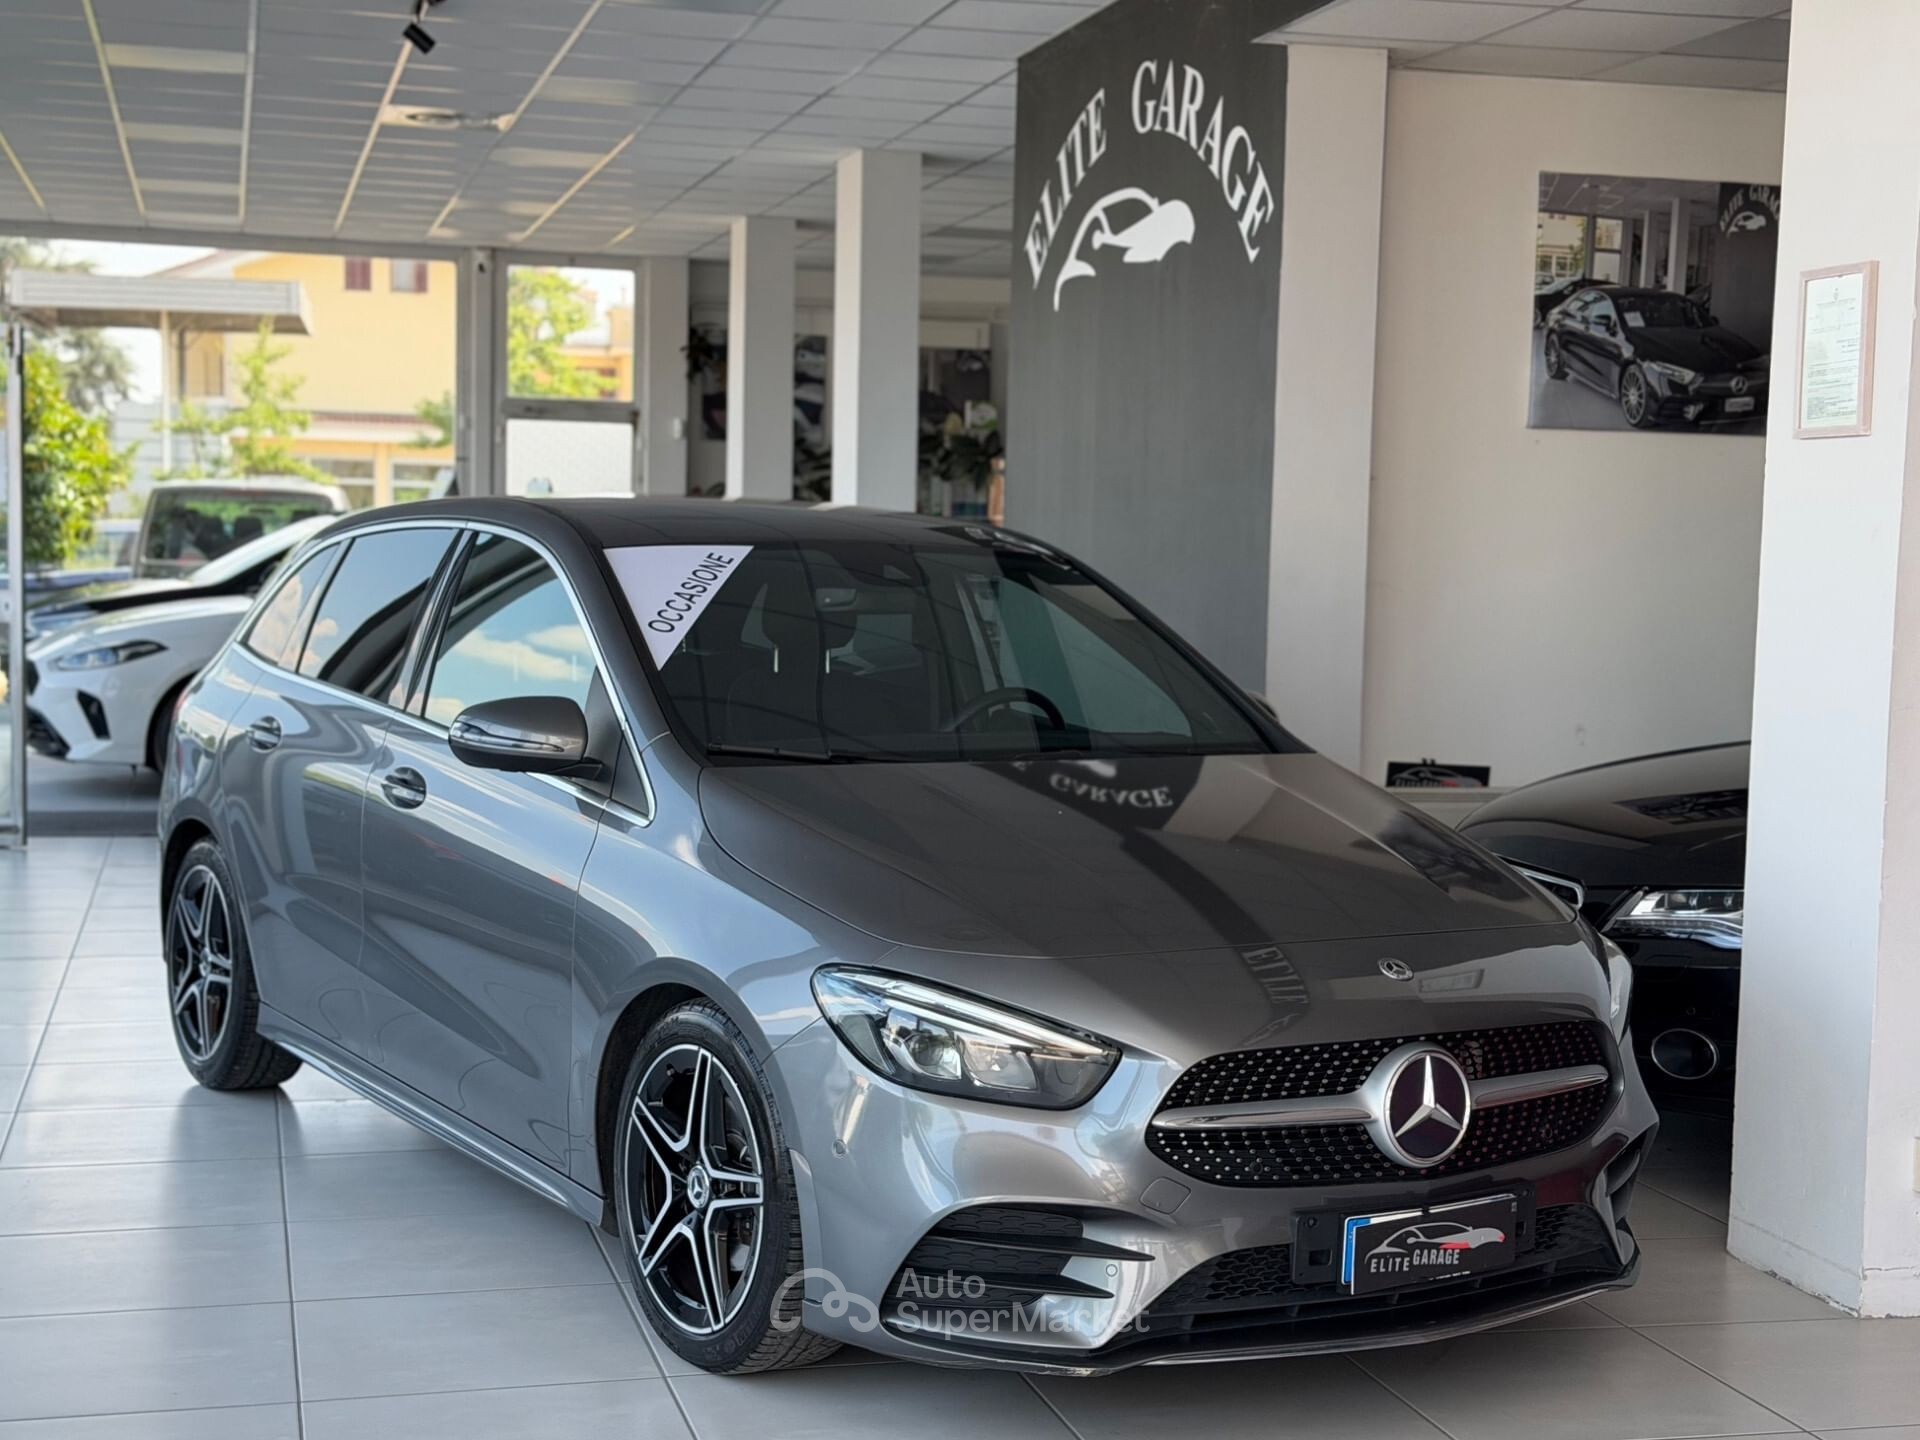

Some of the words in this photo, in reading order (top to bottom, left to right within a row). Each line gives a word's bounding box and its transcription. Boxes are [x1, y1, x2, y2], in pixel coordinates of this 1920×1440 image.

[1025, 88, 1107, 290] ELITE
[1131, 59, 1275, 264] GARAGE
[647, 552, 735, 633] OCCASIONE
[1370, 1257, 1410, 1273] ELITE
[1412, 1248, 1460, 1265] GARAGE
